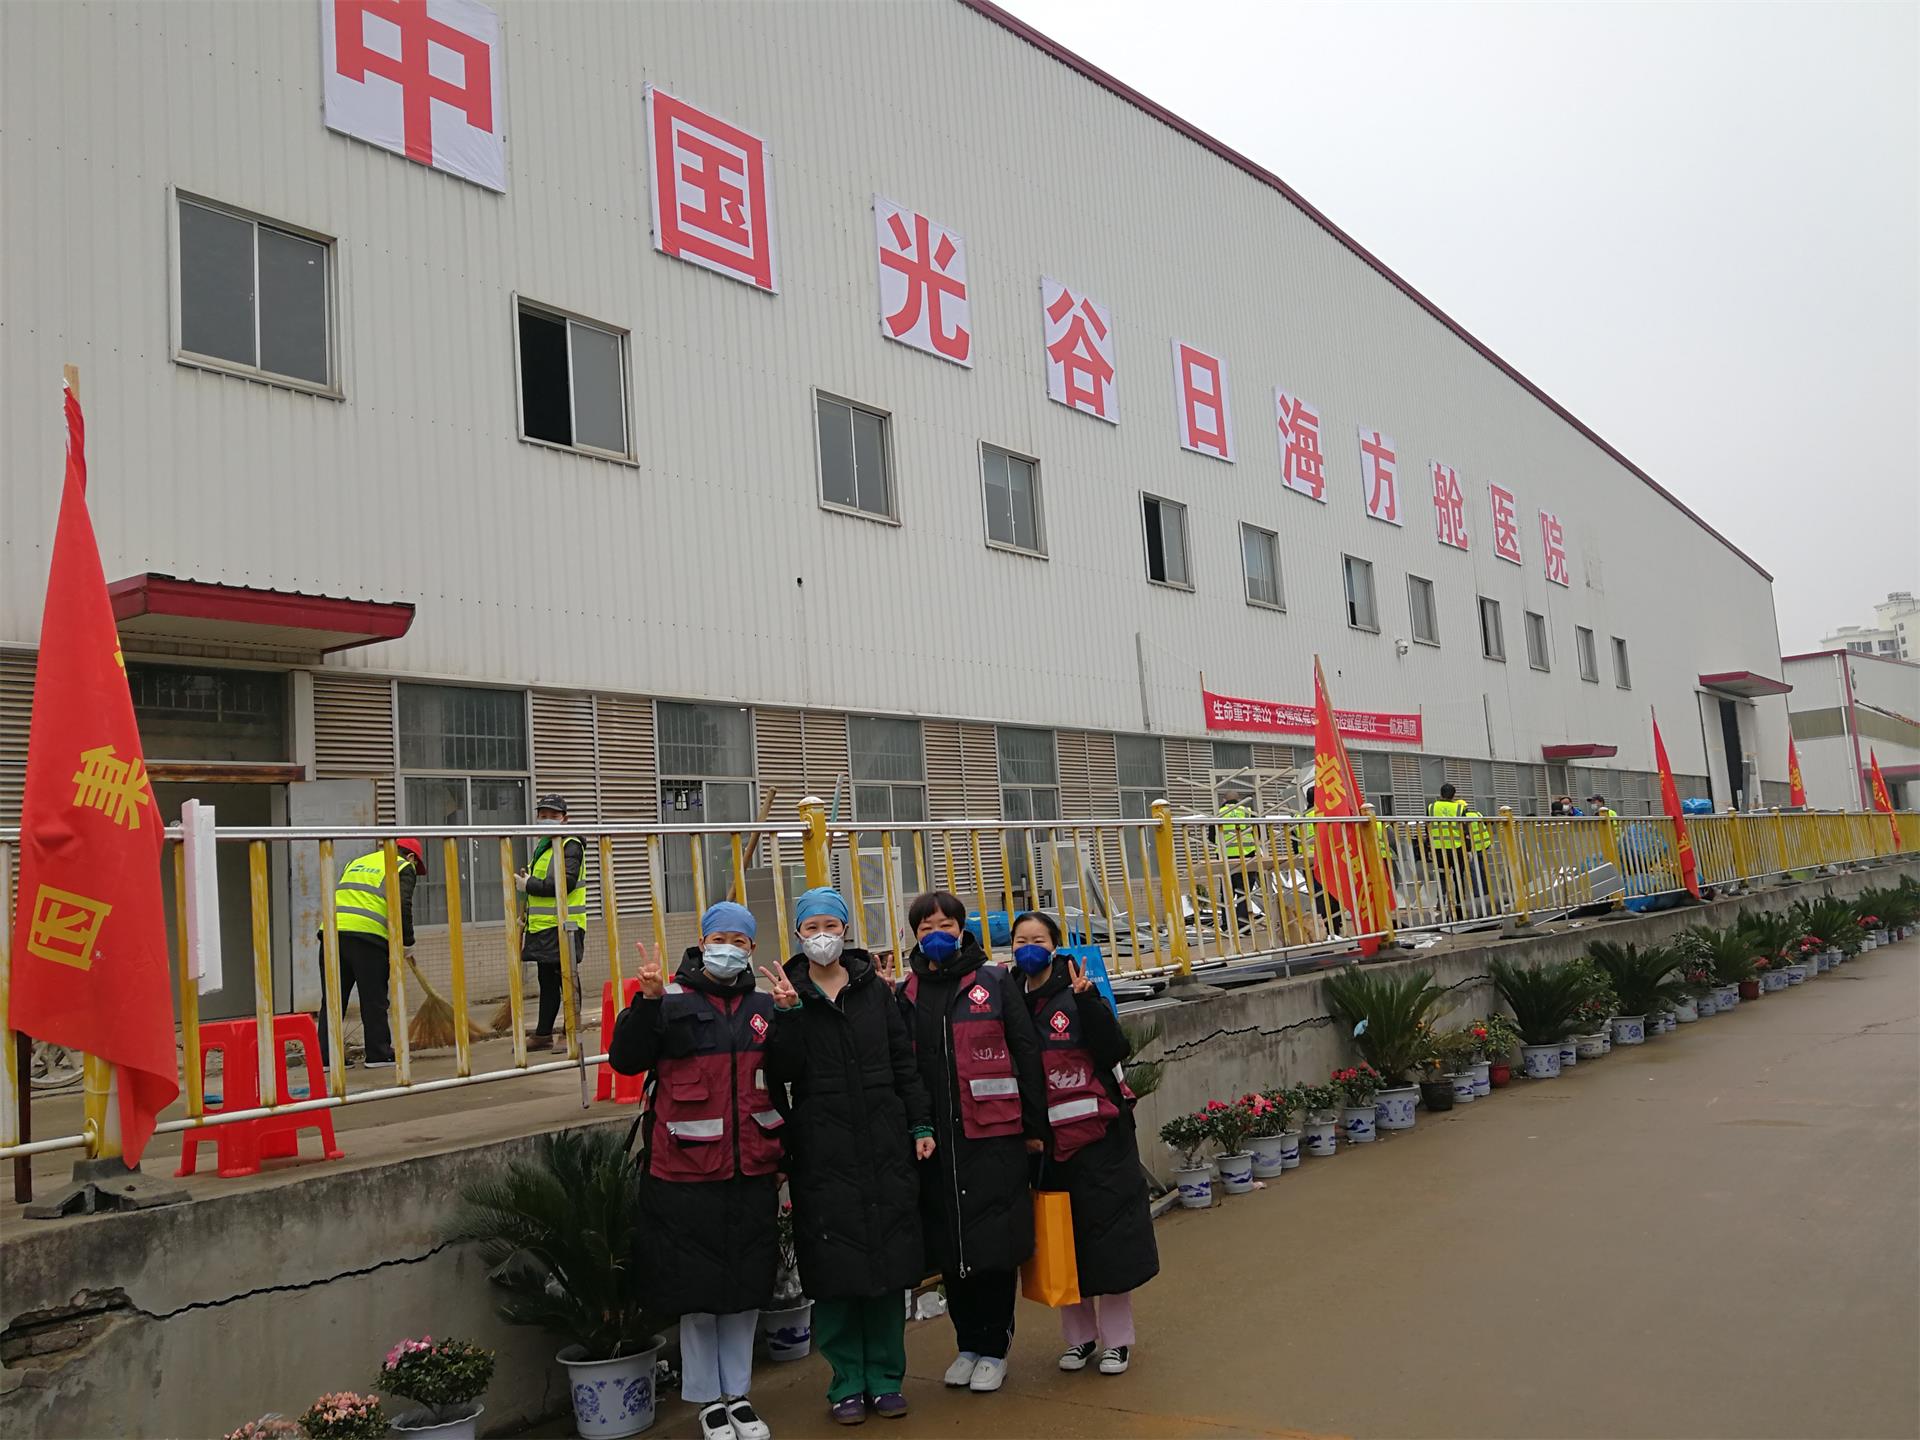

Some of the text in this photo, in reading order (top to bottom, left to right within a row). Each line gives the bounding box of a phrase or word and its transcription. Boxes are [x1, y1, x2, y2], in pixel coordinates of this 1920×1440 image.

[335, 0, 1568, 583] 中国光谷日海方舱医院
[1213, 700, 1272, 724] 生命重于泰山
